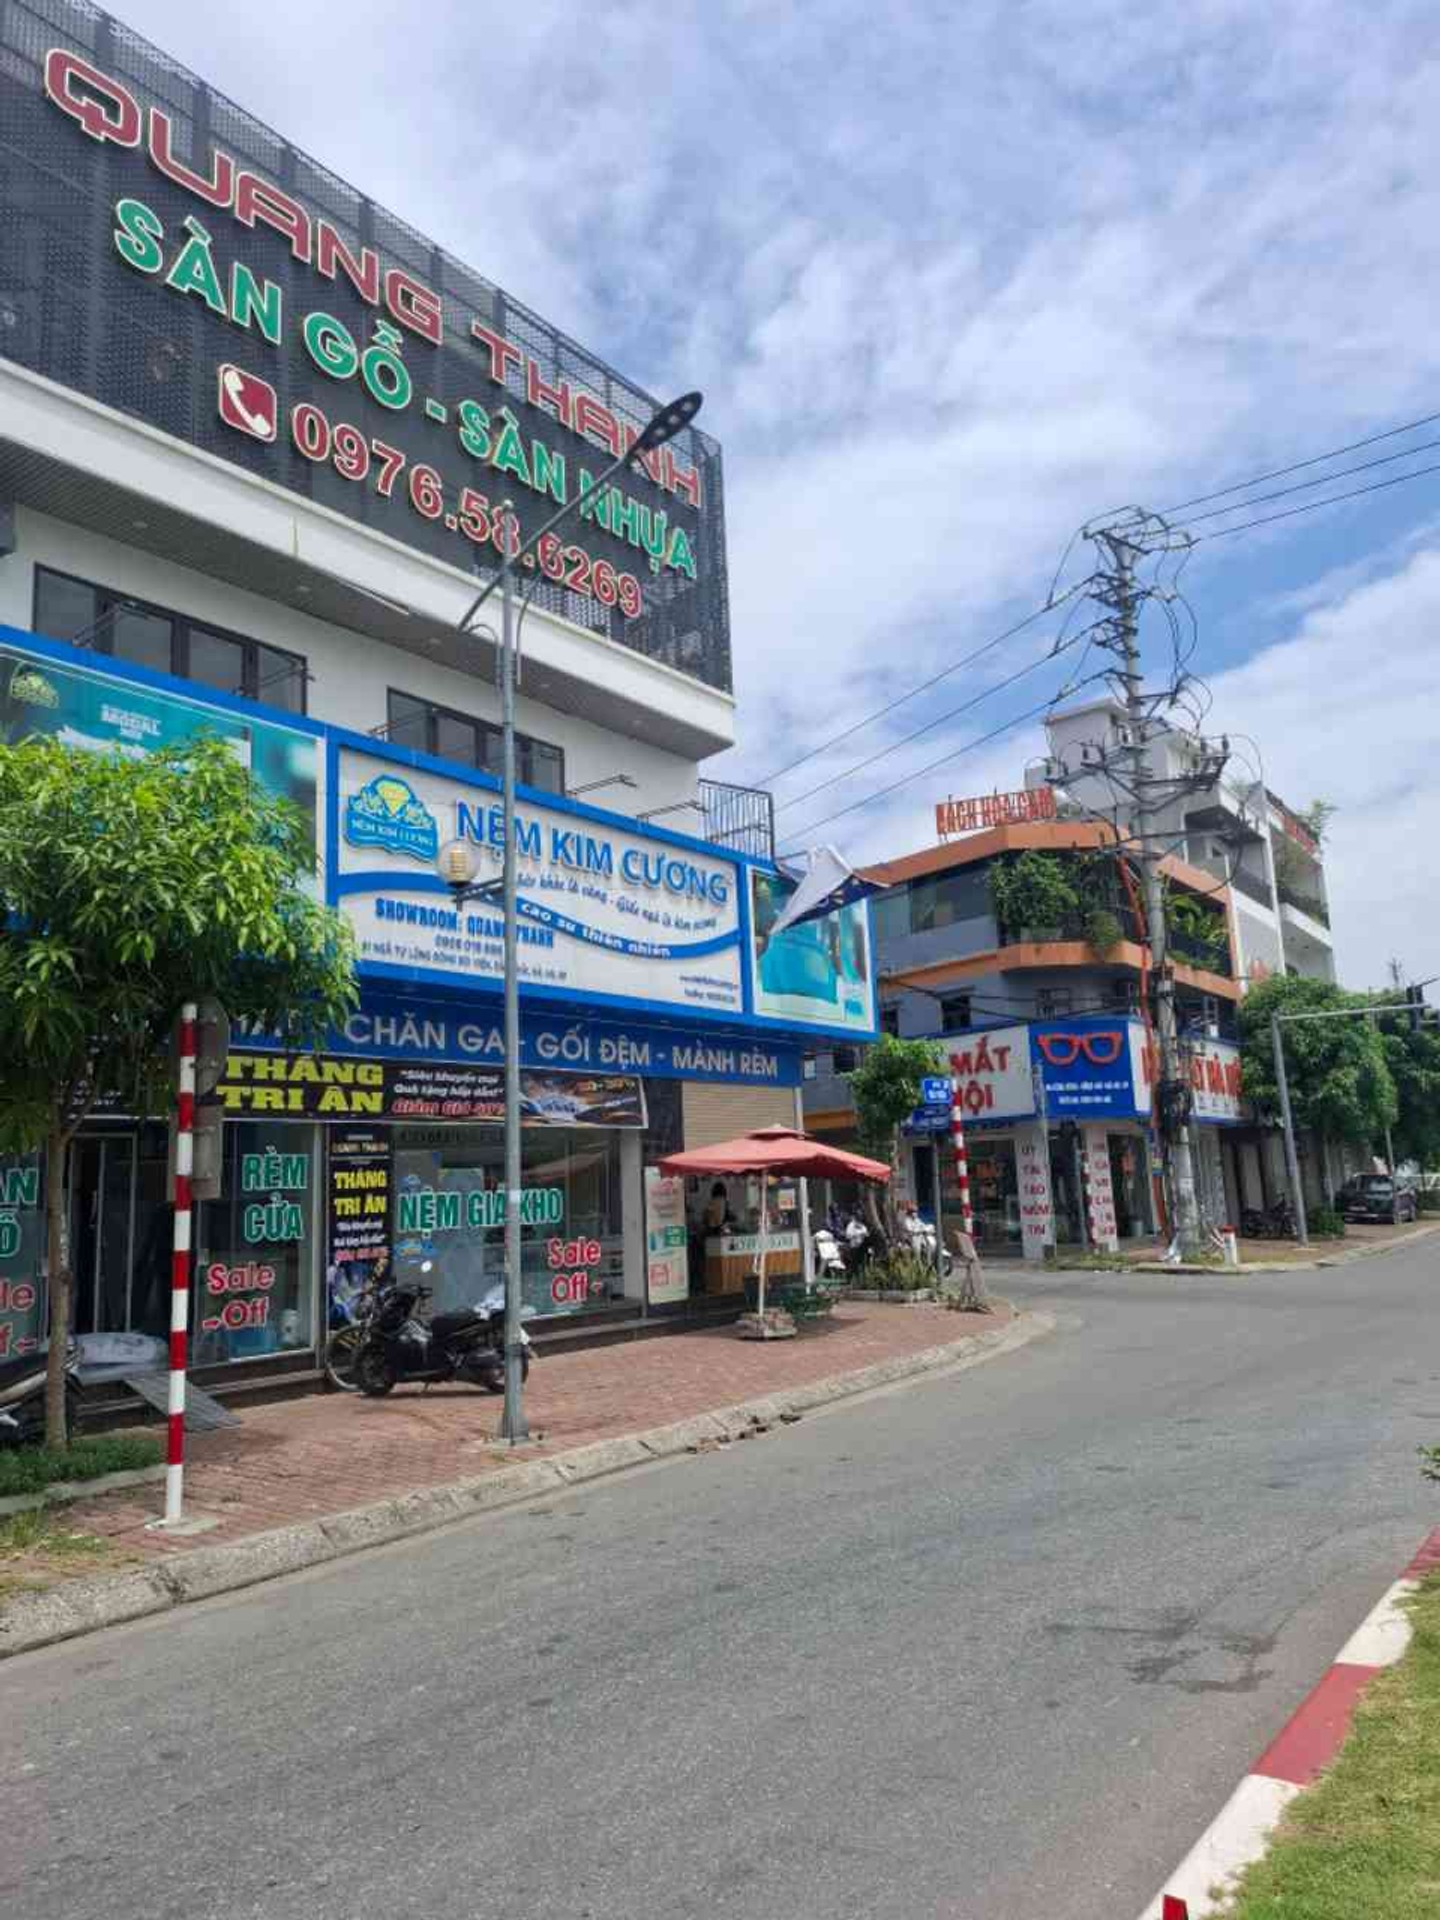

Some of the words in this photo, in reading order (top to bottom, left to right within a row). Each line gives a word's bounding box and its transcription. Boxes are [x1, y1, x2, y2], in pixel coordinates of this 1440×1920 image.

[44, 47, 444, 346] QUANG
[114, 198, 282, 346] SÀN
[303, 318, 412, 410] GỖ
[459, 399, 567, 505] SÀN
[550, 827, 614, 877] KIM
[622, 848, 730, 905] CƯƠNG
[467, 913, 505, 938] QUAN
[521, 902, 552, 922] cao
[343, 1012, 445, 1049] CHĂN
[457, 1024, 506, 1056] GA
[535, 1023, 590, 1061] GỐI
[600, 1034, 651, 1070] ĐỆM
[672, 1038, 736, 1074] MÀNH
[949, 1035, 1011, 1077] MẮT
[225, 1053, 384, 1085] THÁNG
[215, 1085, 304, 1111] TRI
[317, 1085, 384, 1113] ÂN
[334, 1168, 387, 1189] THÁNG
[244, 1192, 305, 1243] CỬA
[334, 1196, 361, 1216] TRI
[364, 1193, 387, 1214] ÂN
[397, 1186, 462, 1240] NỆM
[519, 1188, 565, 1224] KHO
[547, 1236, 601, 1269] Sale
[207, 1262, 276, 1295] Sale
